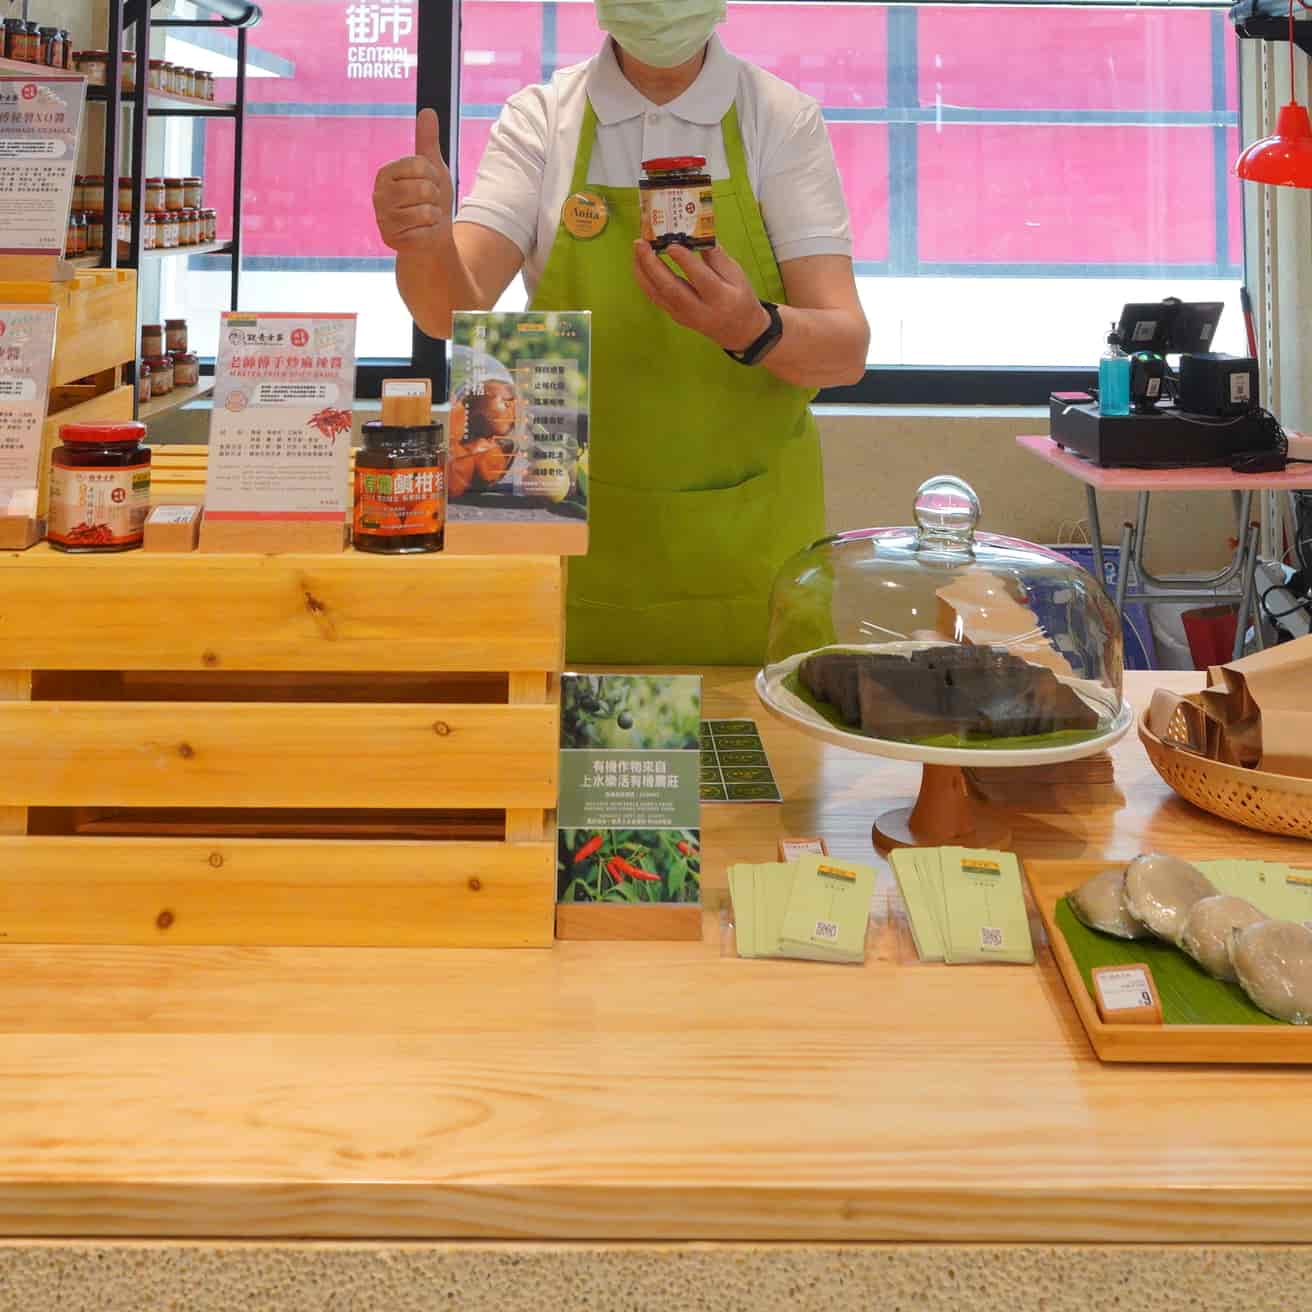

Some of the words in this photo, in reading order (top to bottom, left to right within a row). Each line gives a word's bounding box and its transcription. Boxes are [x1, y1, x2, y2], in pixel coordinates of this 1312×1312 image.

[346, 4, 413, 43] 街市
[347, 47, 409, 62] CENTRAL
[347, 63, 410, 79] MARKET
